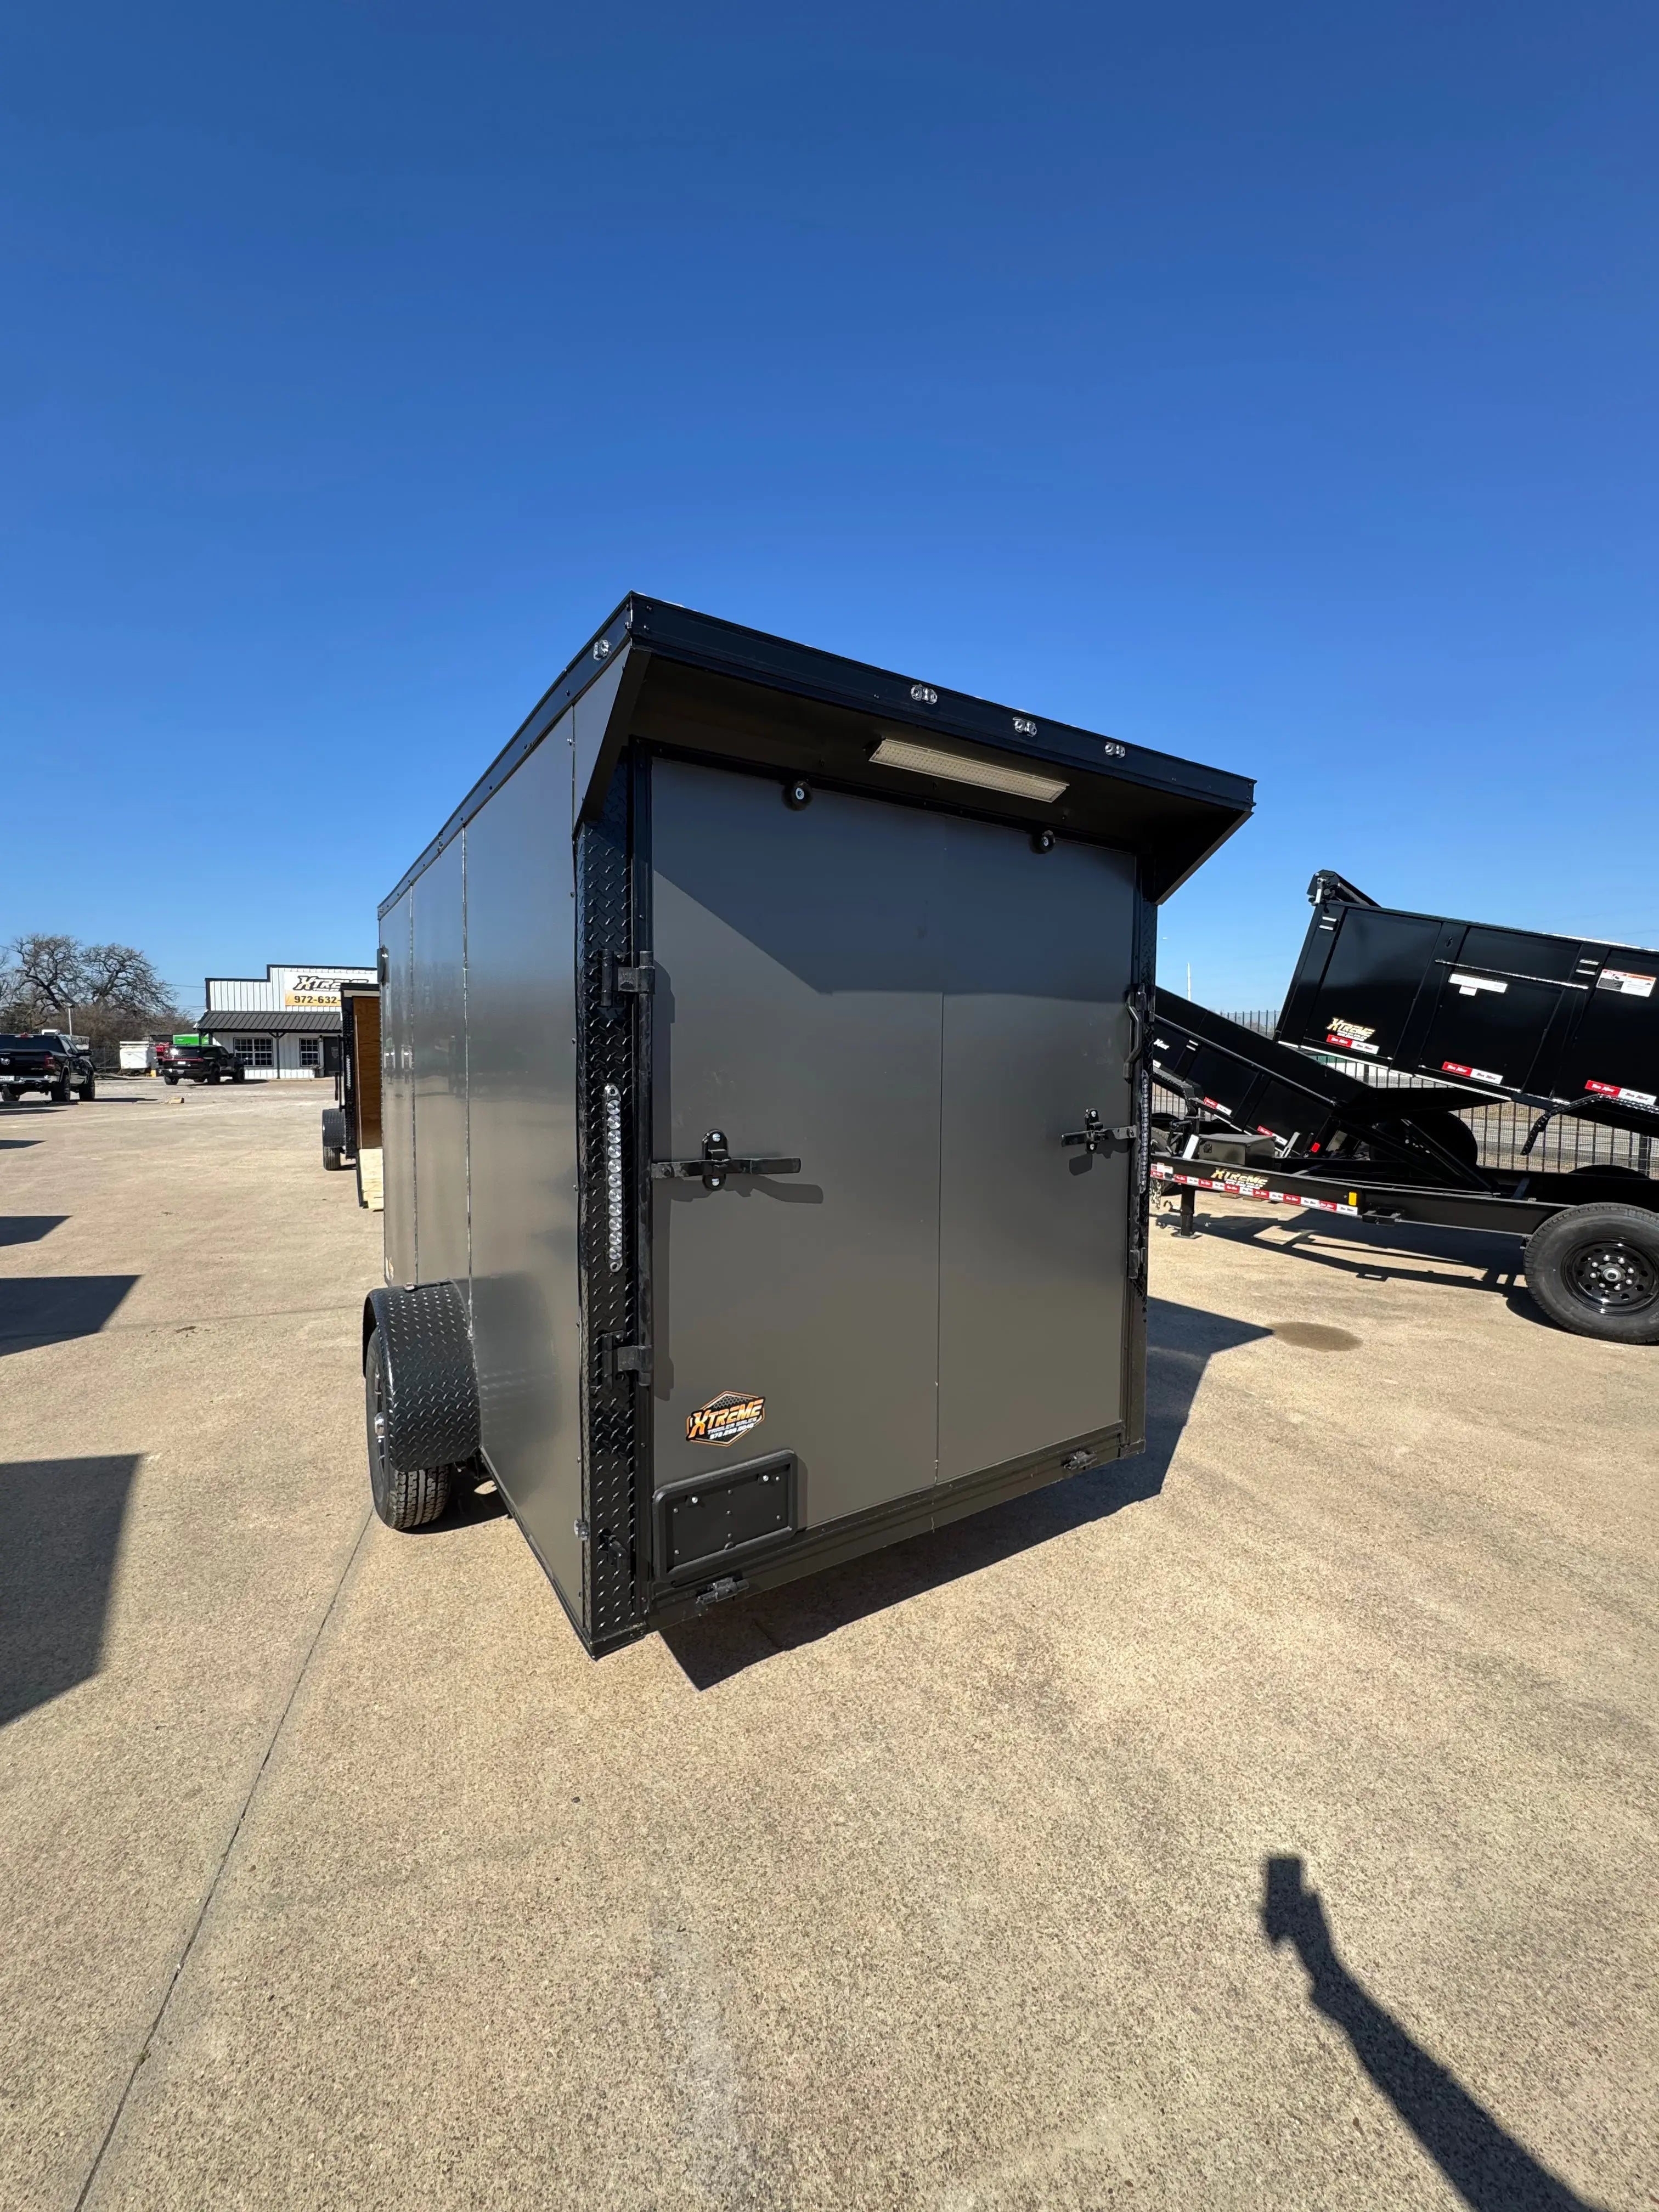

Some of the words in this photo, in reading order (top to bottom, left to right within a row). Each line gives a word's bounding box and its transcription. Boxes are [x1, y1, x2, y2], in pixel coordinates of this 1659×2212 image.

[293, 975, 369, 991] XTRE
[1211, 1167, 1268, 1185] XTREME
[688, 1398, 764, 1438] XTREME
